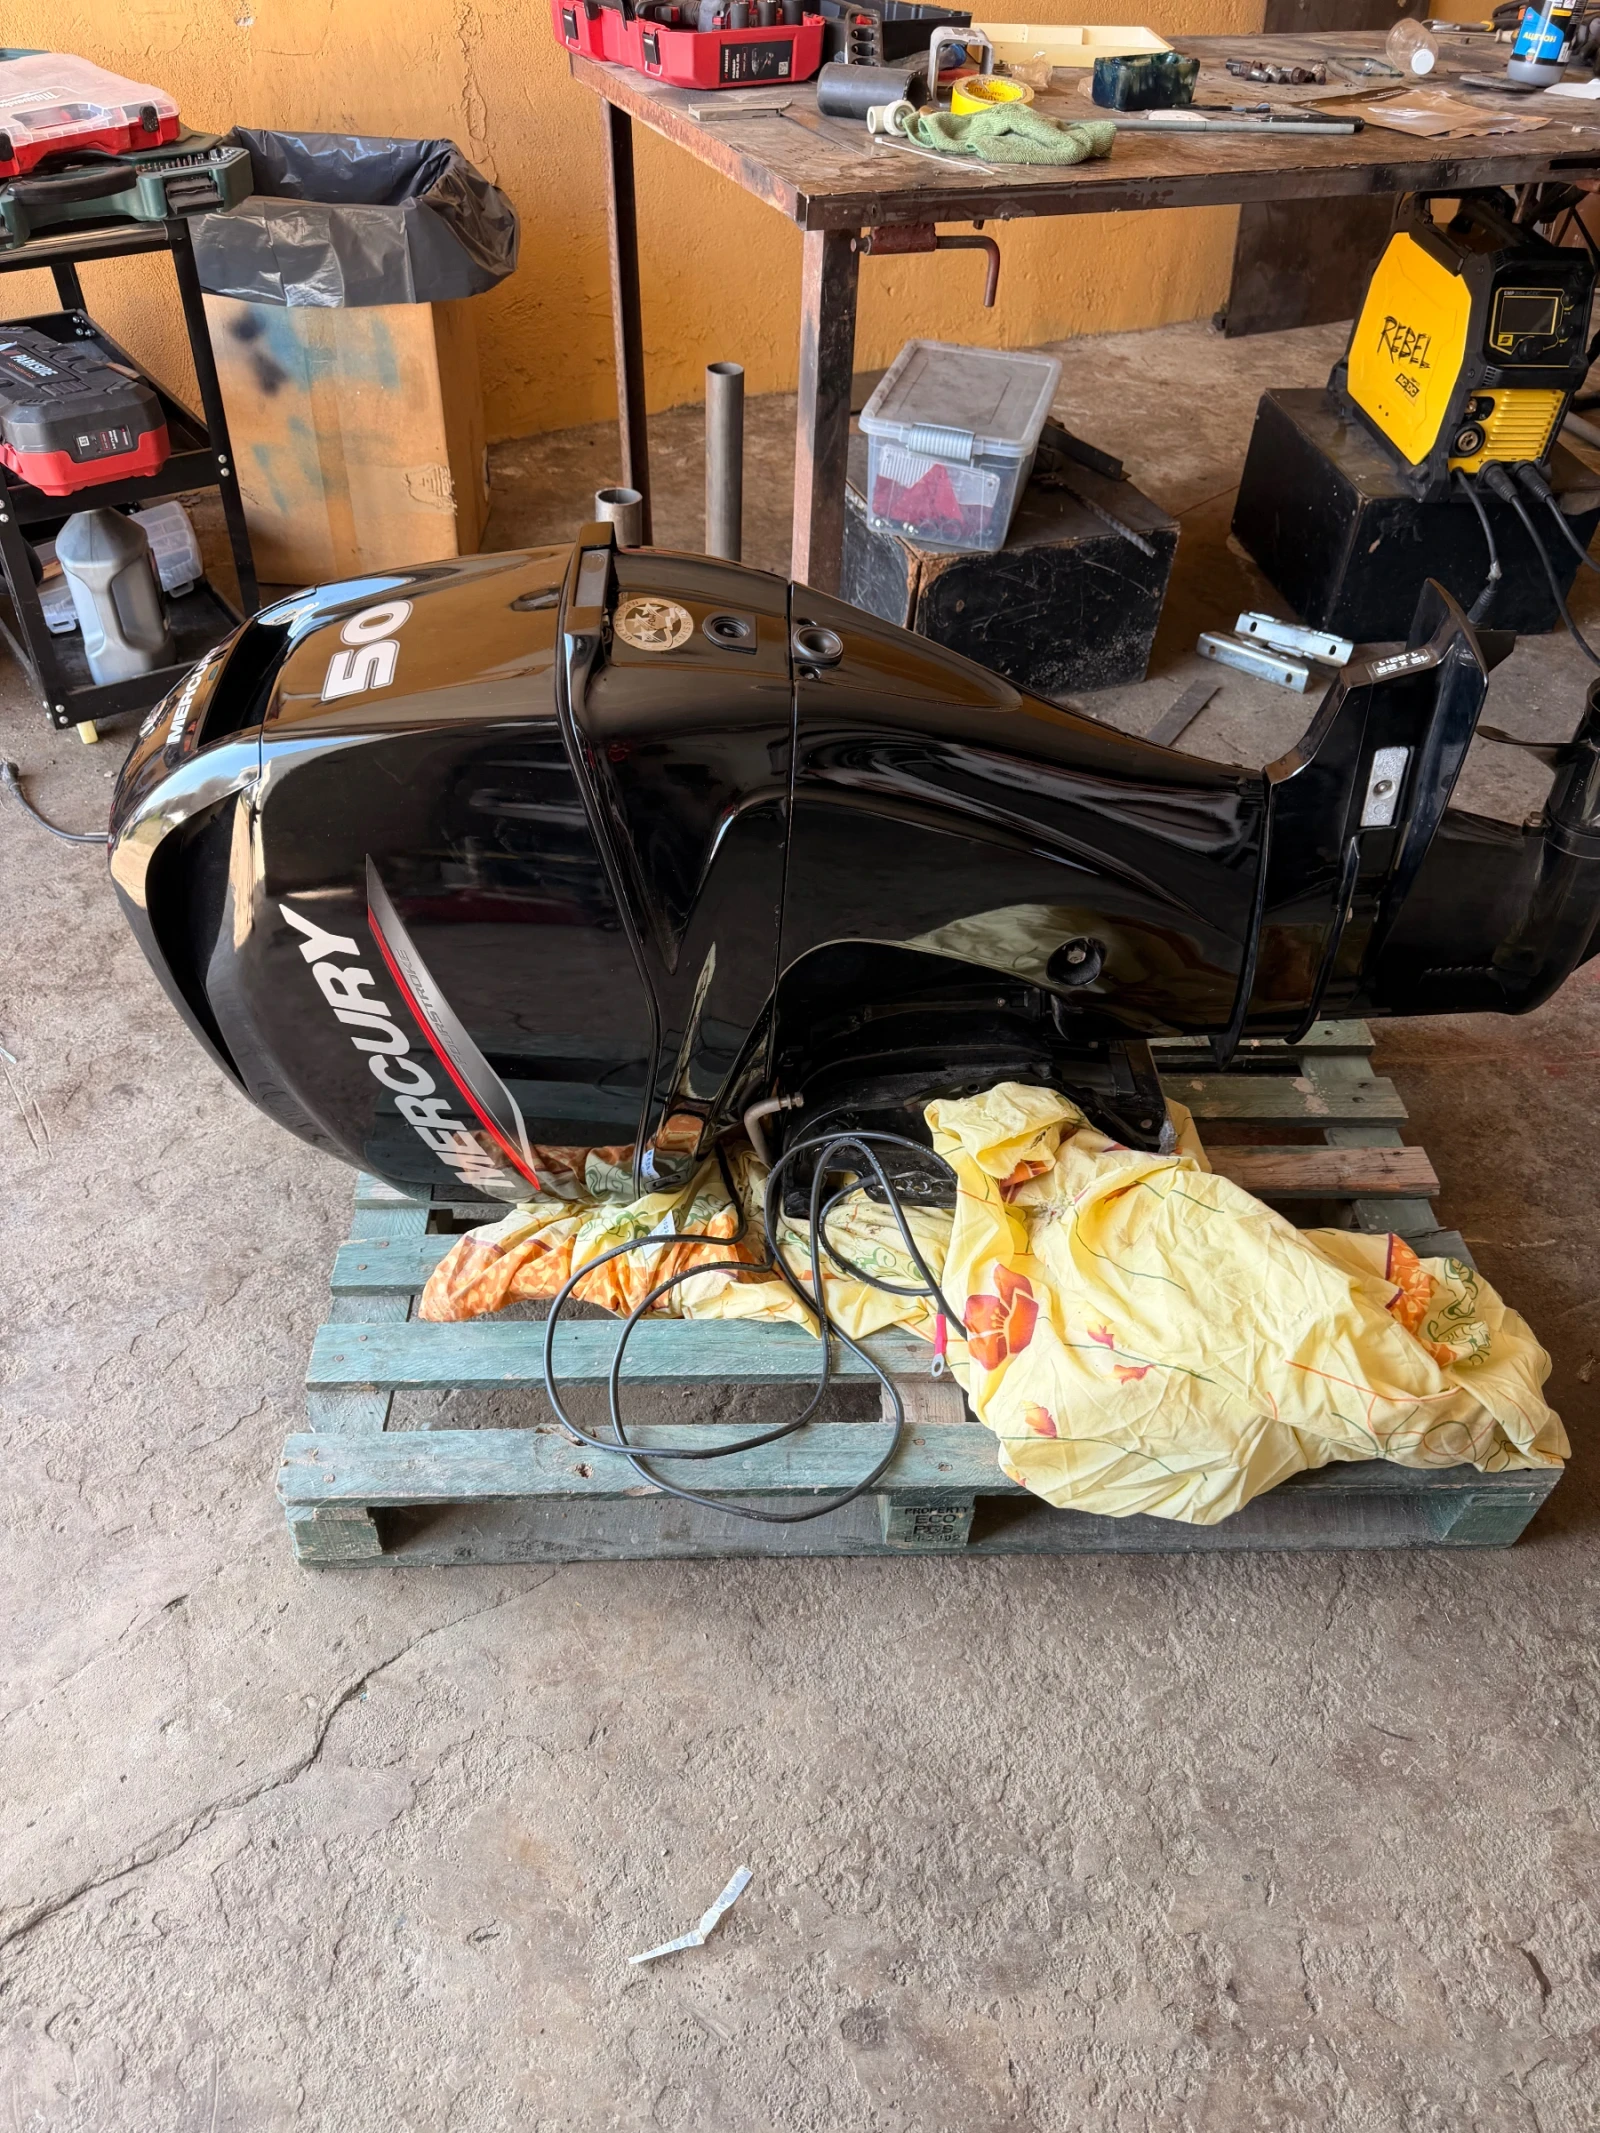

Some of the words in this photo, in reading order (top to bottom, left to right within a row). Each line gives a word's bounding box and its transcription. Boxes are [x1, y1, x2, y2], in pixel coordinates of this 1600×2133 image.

[1377, 315, 1431, 369] REBEL
[321, 600, 413, 702] 50
[279, 903, 516, 1188] MERCURY
[395, 948, 468, 1066] FOURSTROKE
[904, 1506, 969, 1515] PROPERTY
[914, 1514, 957, 1525] ECO
